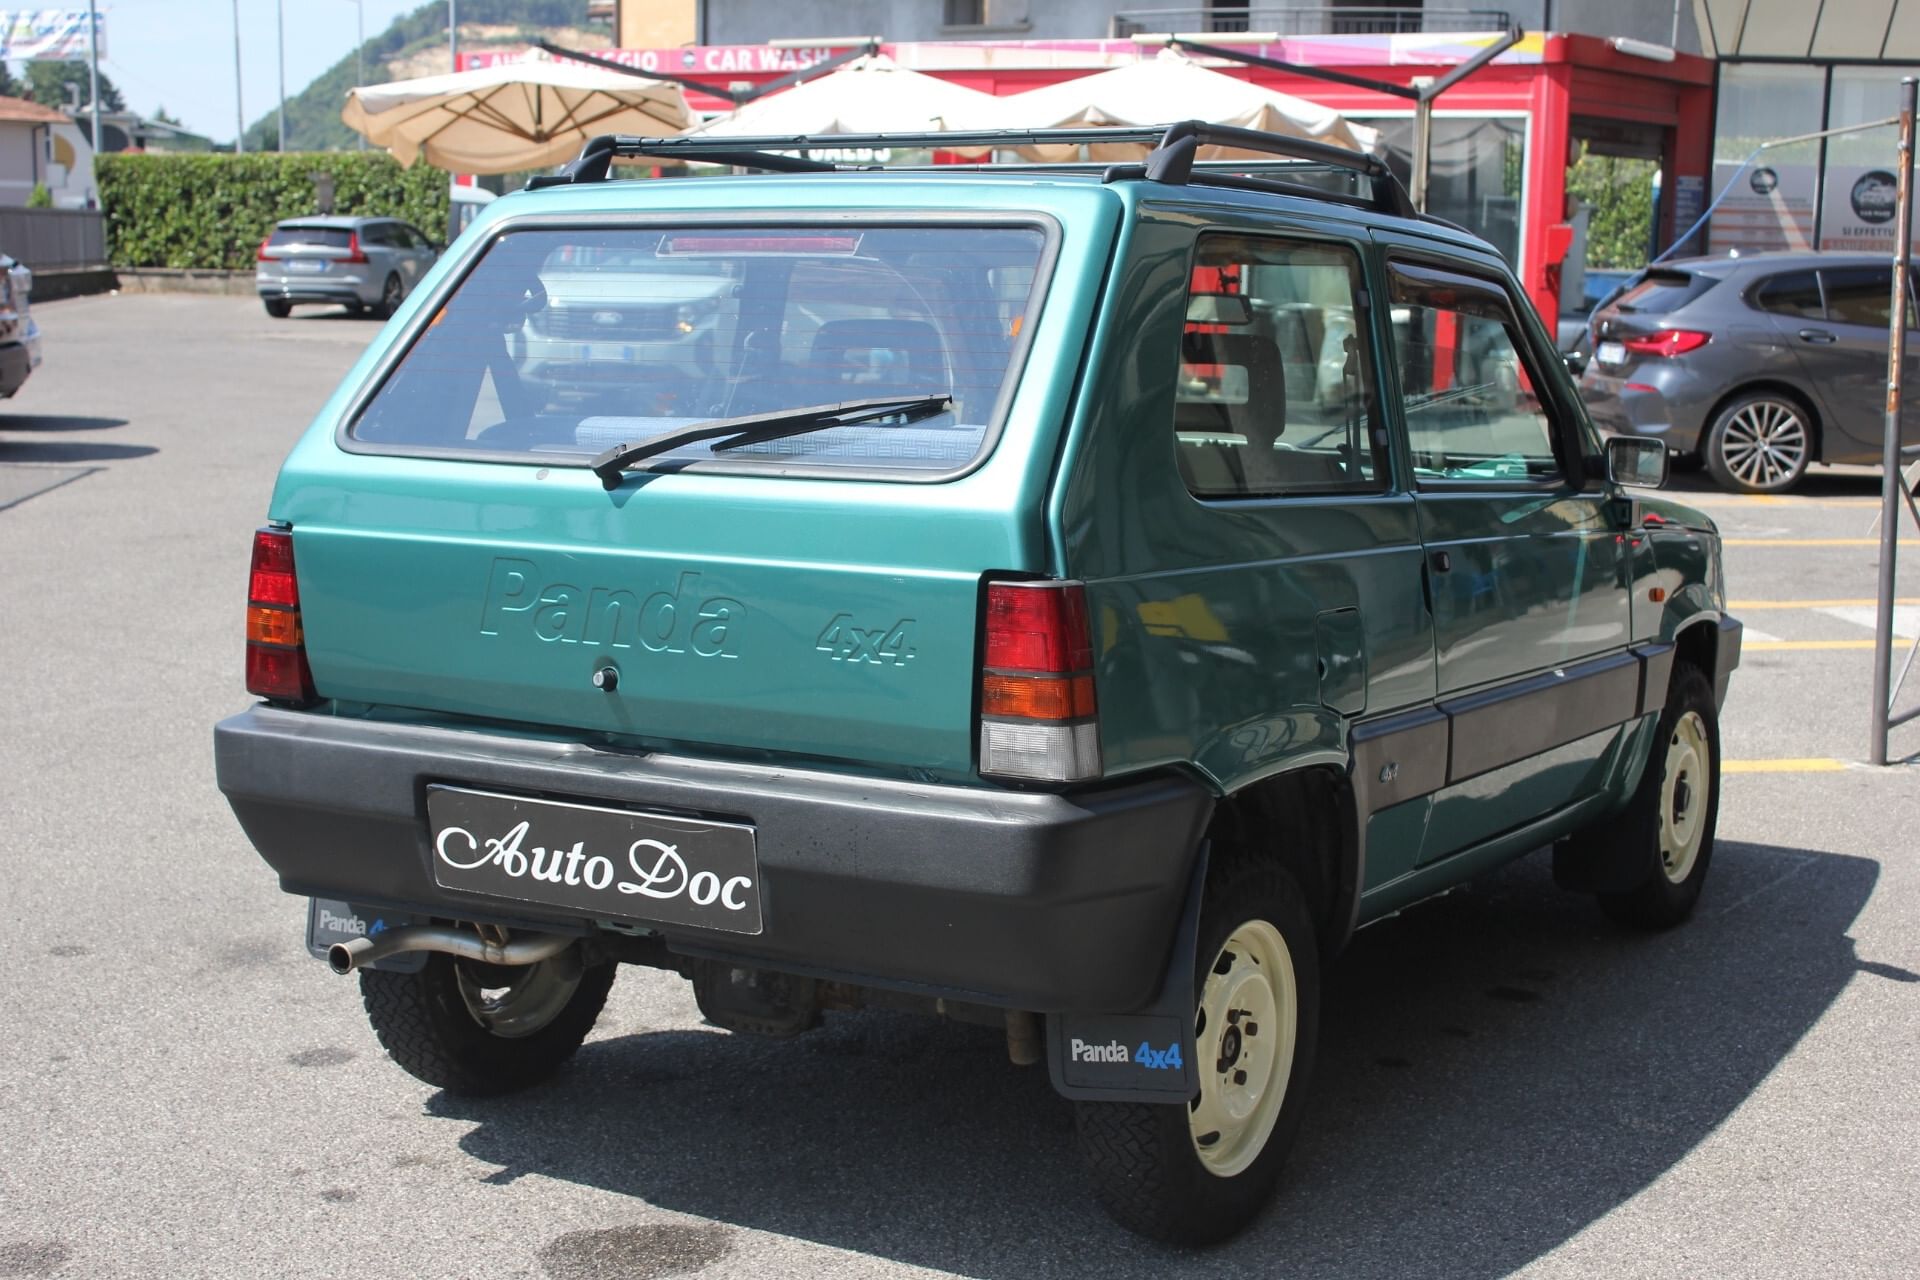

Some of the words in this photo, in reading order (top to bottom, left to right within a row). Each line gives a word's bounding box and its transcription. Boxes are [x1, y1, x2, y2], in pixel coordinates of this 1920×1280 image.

[704, 48, 752, 71] CAR
[479, 556, 748, 659] Panda
[815, 613, 917, 667] 4x4
[436, 821, 614, 890] Auto
[617, 838, 752, 911] Doc
[320, 909, 367, 935] Panda
[1071, 1038, 1129, 1063] Panda
[1134, 1041, 1183, 1070] 4x4
